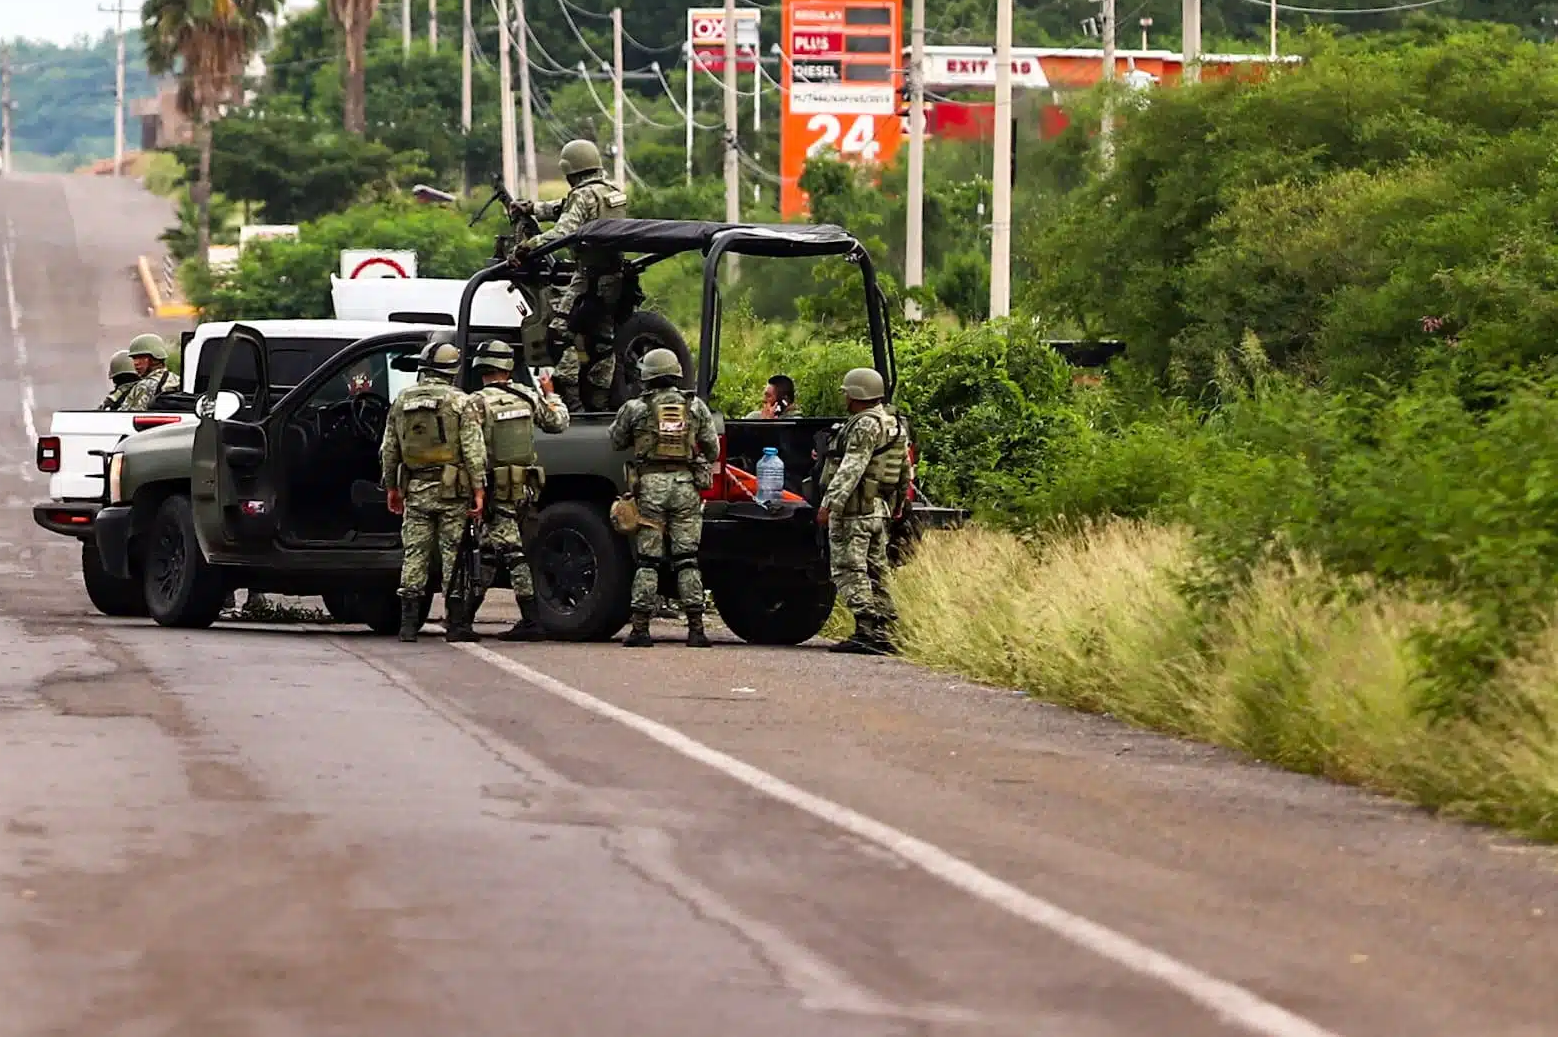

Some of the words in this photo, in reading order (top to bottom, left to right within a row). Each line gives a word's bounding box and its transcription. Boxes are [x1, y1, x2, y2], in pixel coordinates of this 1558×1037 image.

[795, 36, 830, 52] PLUS
[794, 65, 838, 79] DIESEL
[947, 59, 989, 74] EXIT
[806, 114, 880, 160] 24
